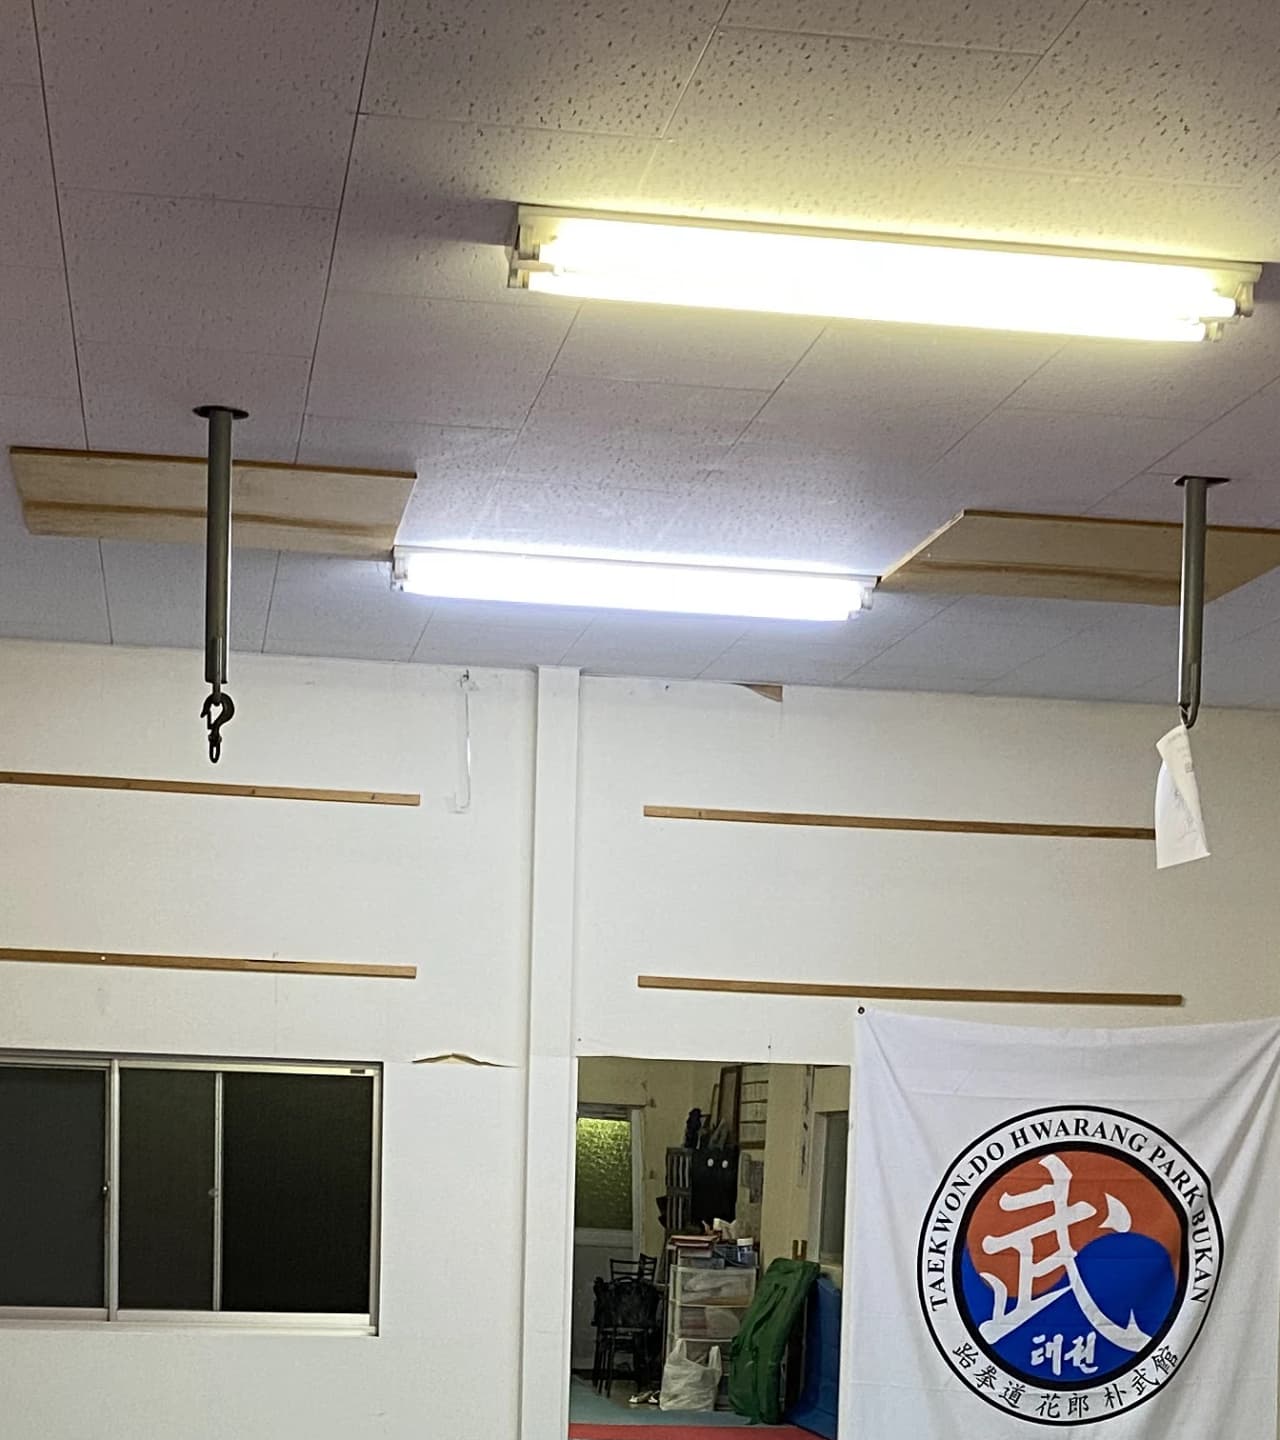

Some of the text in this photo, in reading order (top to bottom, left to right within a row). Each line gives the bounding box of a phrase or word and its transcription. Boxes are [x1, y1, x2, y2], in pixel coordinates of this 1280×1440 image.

[928, 1117, 1214, 1312] TAEKWON-DO HWARANG PARK BUKAN
[978, 1153, 1152, 1352] 武
[952, 1343, 1026, 1410] 跆拳道
[1035, 1392, 1090, 1418] 花郎
[1030, 1331, 1099, 1376] 태권
